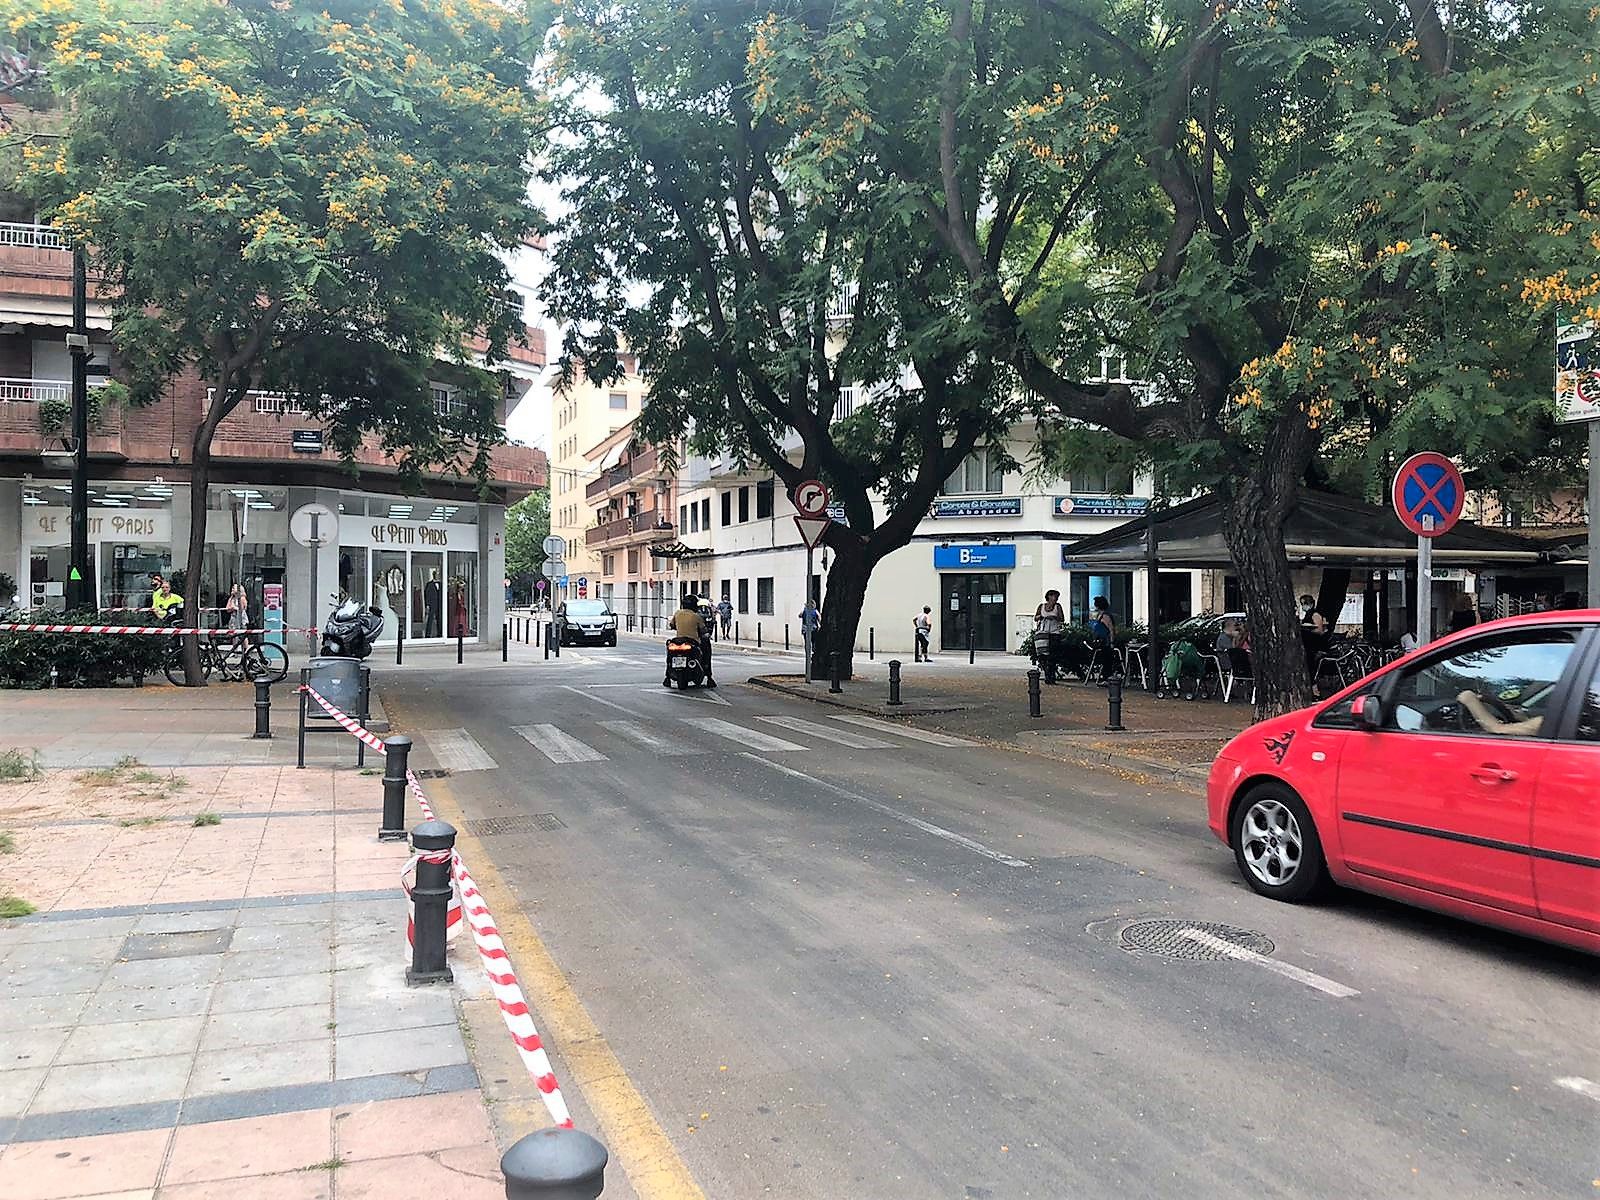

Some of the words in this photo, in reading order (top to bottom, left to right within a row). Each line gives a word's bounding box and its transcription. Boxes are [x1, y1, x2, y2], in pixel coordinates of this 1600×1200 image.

[111, 515, 154, 535] PARIS
[371, 524, 385, 543] LE
[387, 522, 416, 545] PETIT
[418, 524, 448, 546] PARIS
